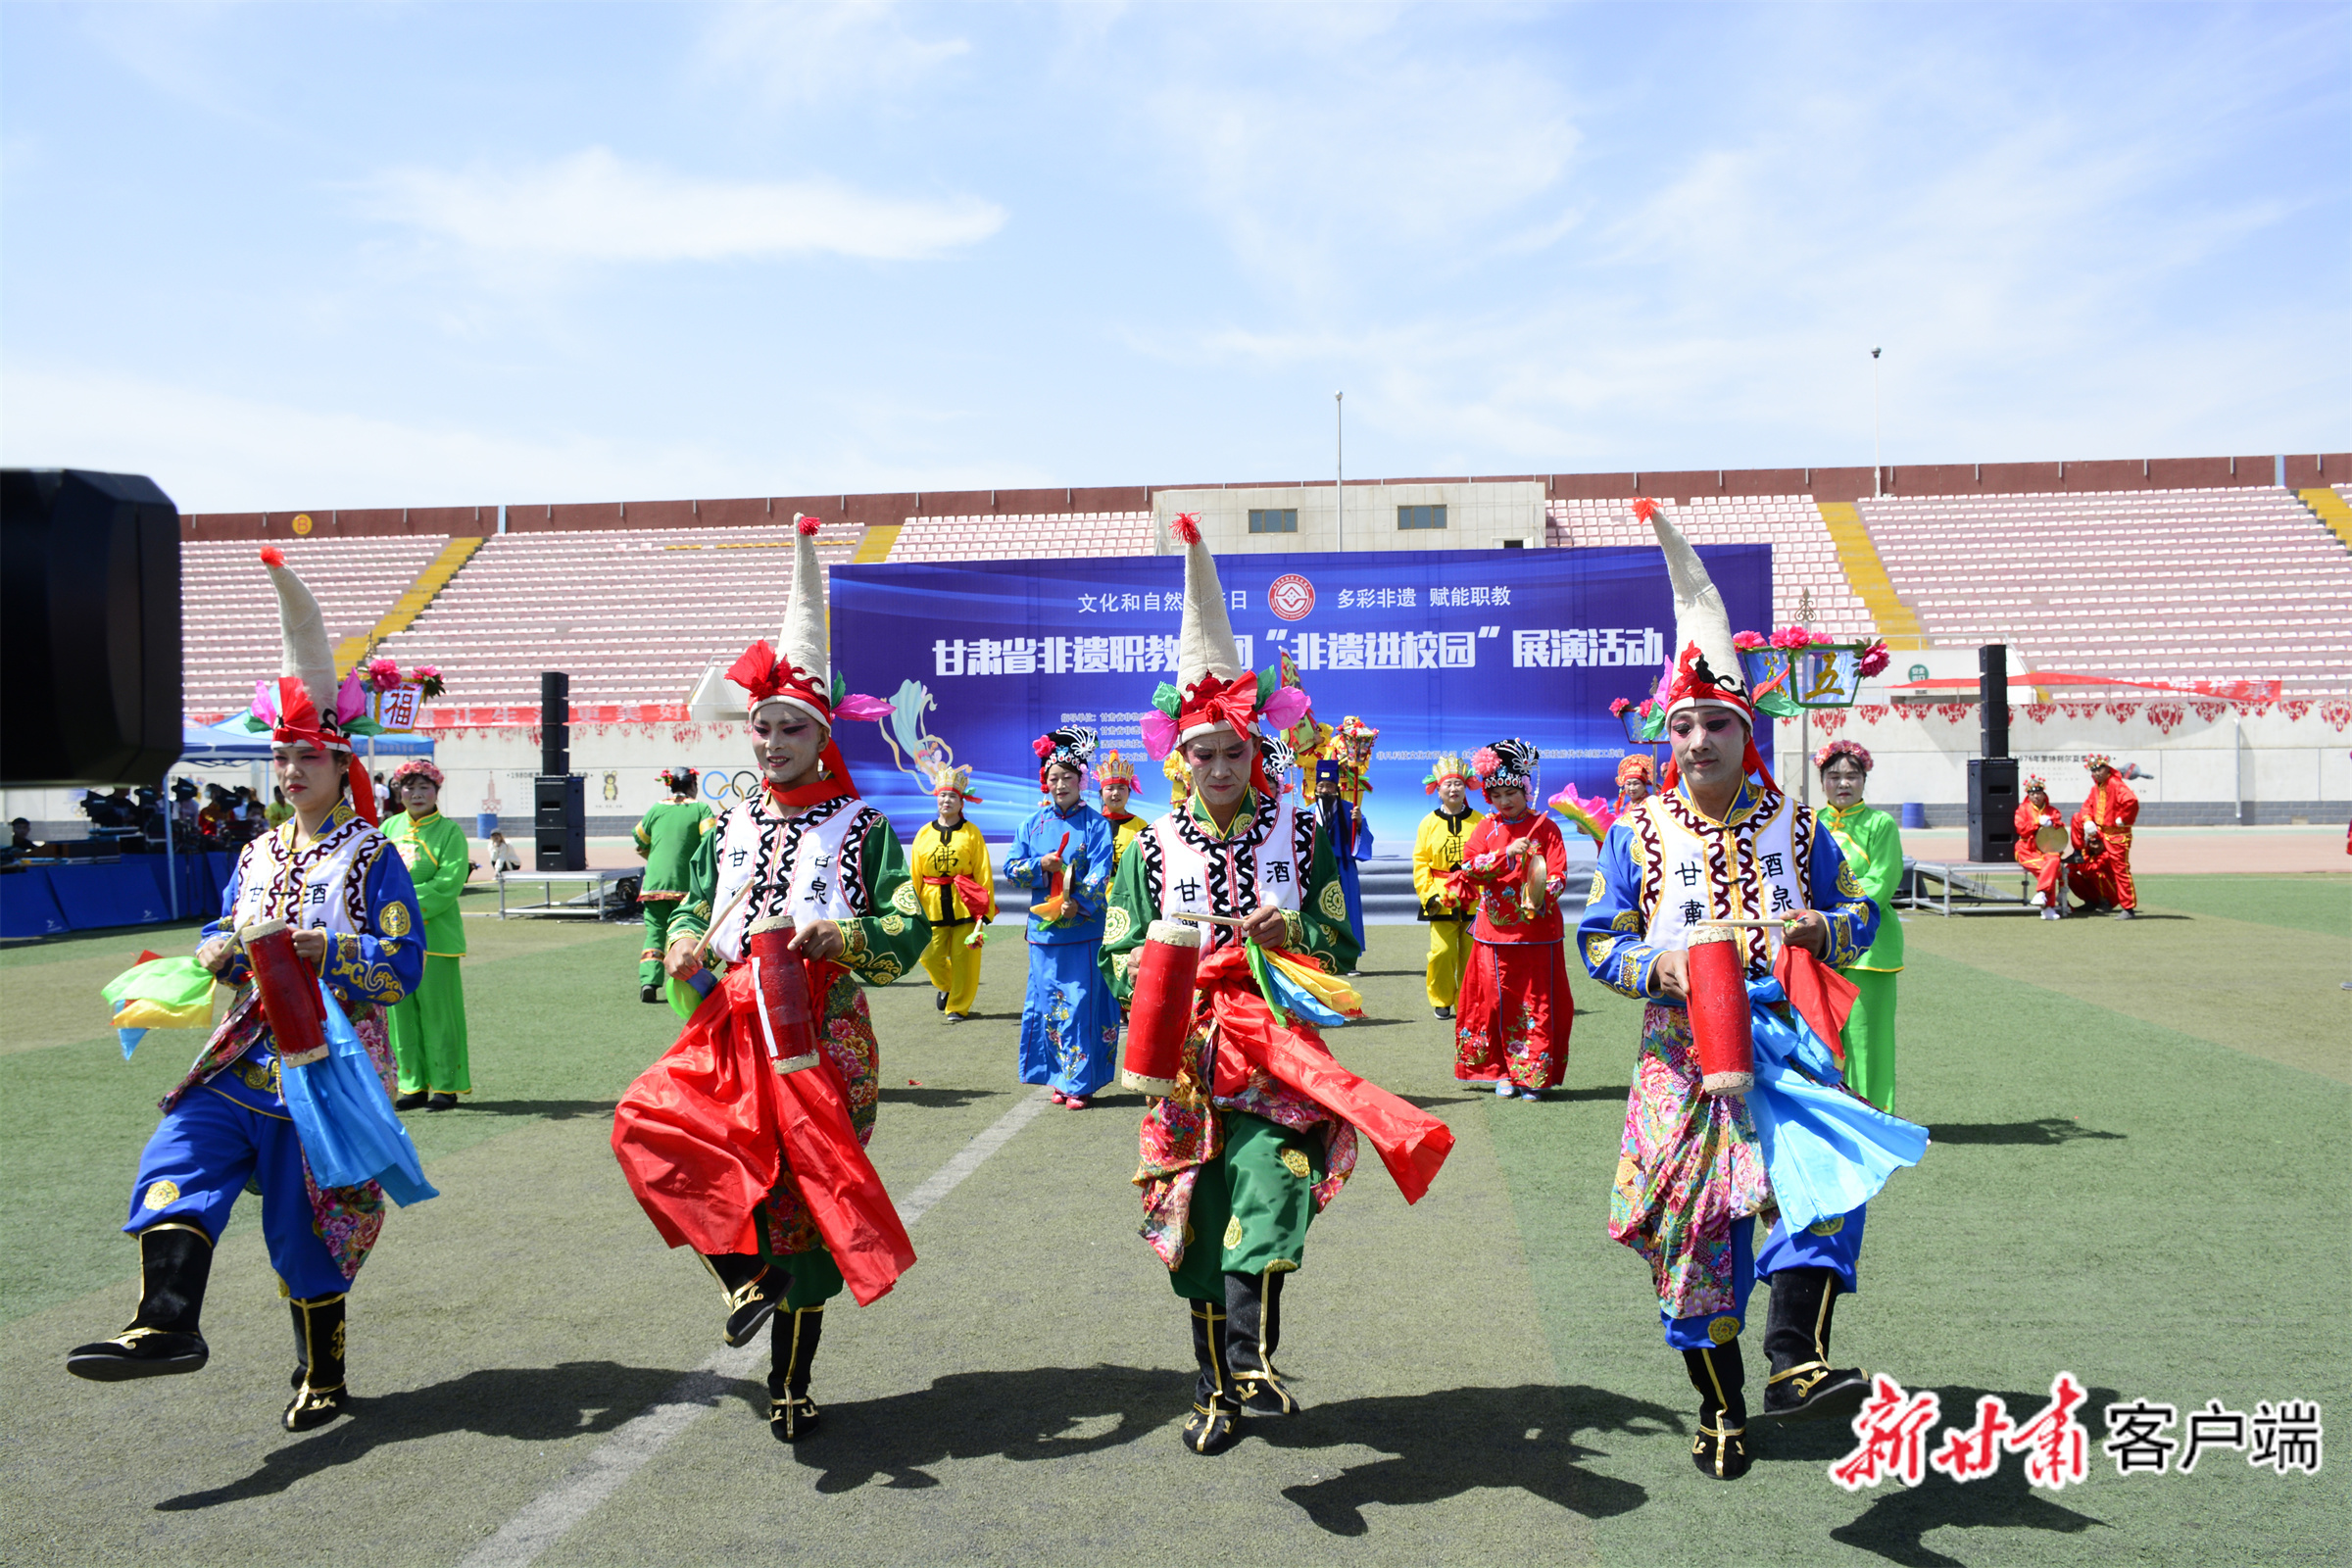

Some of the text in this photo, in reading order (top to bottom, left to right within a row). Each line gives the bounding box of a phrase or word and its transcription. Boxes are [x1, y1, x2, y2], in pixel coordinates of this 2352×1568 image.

[297, 517, 309, 532] B
[1078, 591, 1247, 613] 文化和自然日
[1338, 588, 1417, 608] 多彩非遗
[1430, 586, 1511, 607] 赋能职教
[1804, 651, 1844, 701] 五
[385, 684, 416, 725] 福
[415, 704, 685, 727] 遗让生更美好
[1100, 726, 1142, 736] 甘肃省非遗
[928, 844, 959, 873] 佛
[1758, 853, 1795, 913] 酒泉
